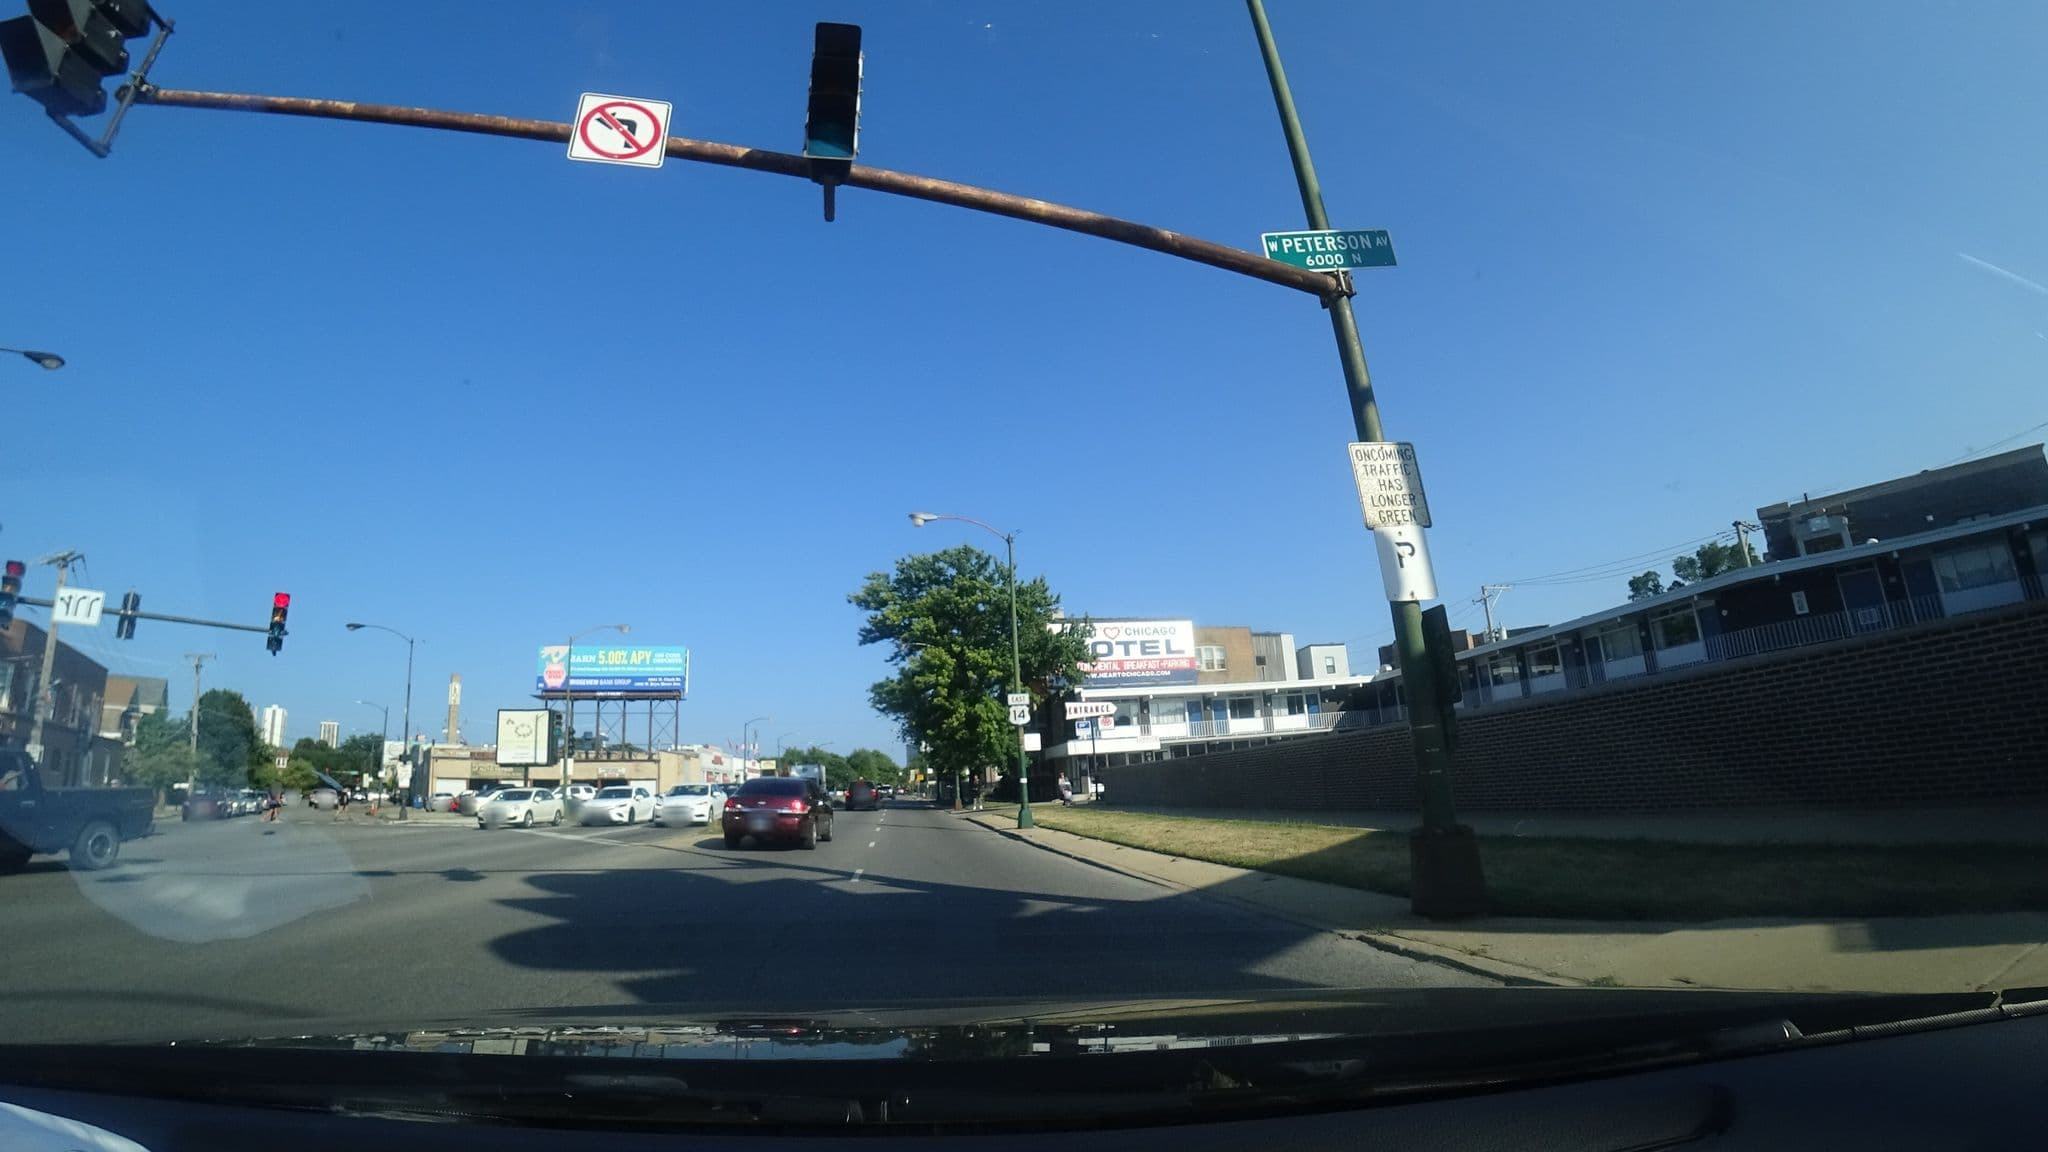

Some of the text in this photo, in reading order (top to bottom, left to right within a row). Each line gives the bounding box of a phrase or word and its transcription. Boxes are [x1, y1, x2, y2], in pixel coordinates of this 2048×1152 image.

[1269, 236, 1388, 253] W PETERSON AV
[1306, 254, 1362, 265] 6000 N
[1354, 448, 1413, 462] ONCOMING
[1363, 463, 1412, 477] TRAFFIC
[1378, 478, 1404, 491] HAS
[1371, 494, 1417, 507] LONGER
[1378, 509, 1418, 523] GREEN
[1124, 626, 1177, 637] CHICAGO
[1090, 639, 1186, 658] OTEL
[598, 649, 628, 665] 5.00%
[629, 649, 653, 665] APY
[1011, 695, 1025, 703] EAST
[1012, 709, 1026, 721] 14
[1068, 703, 1111, 716] ENTRANCE
